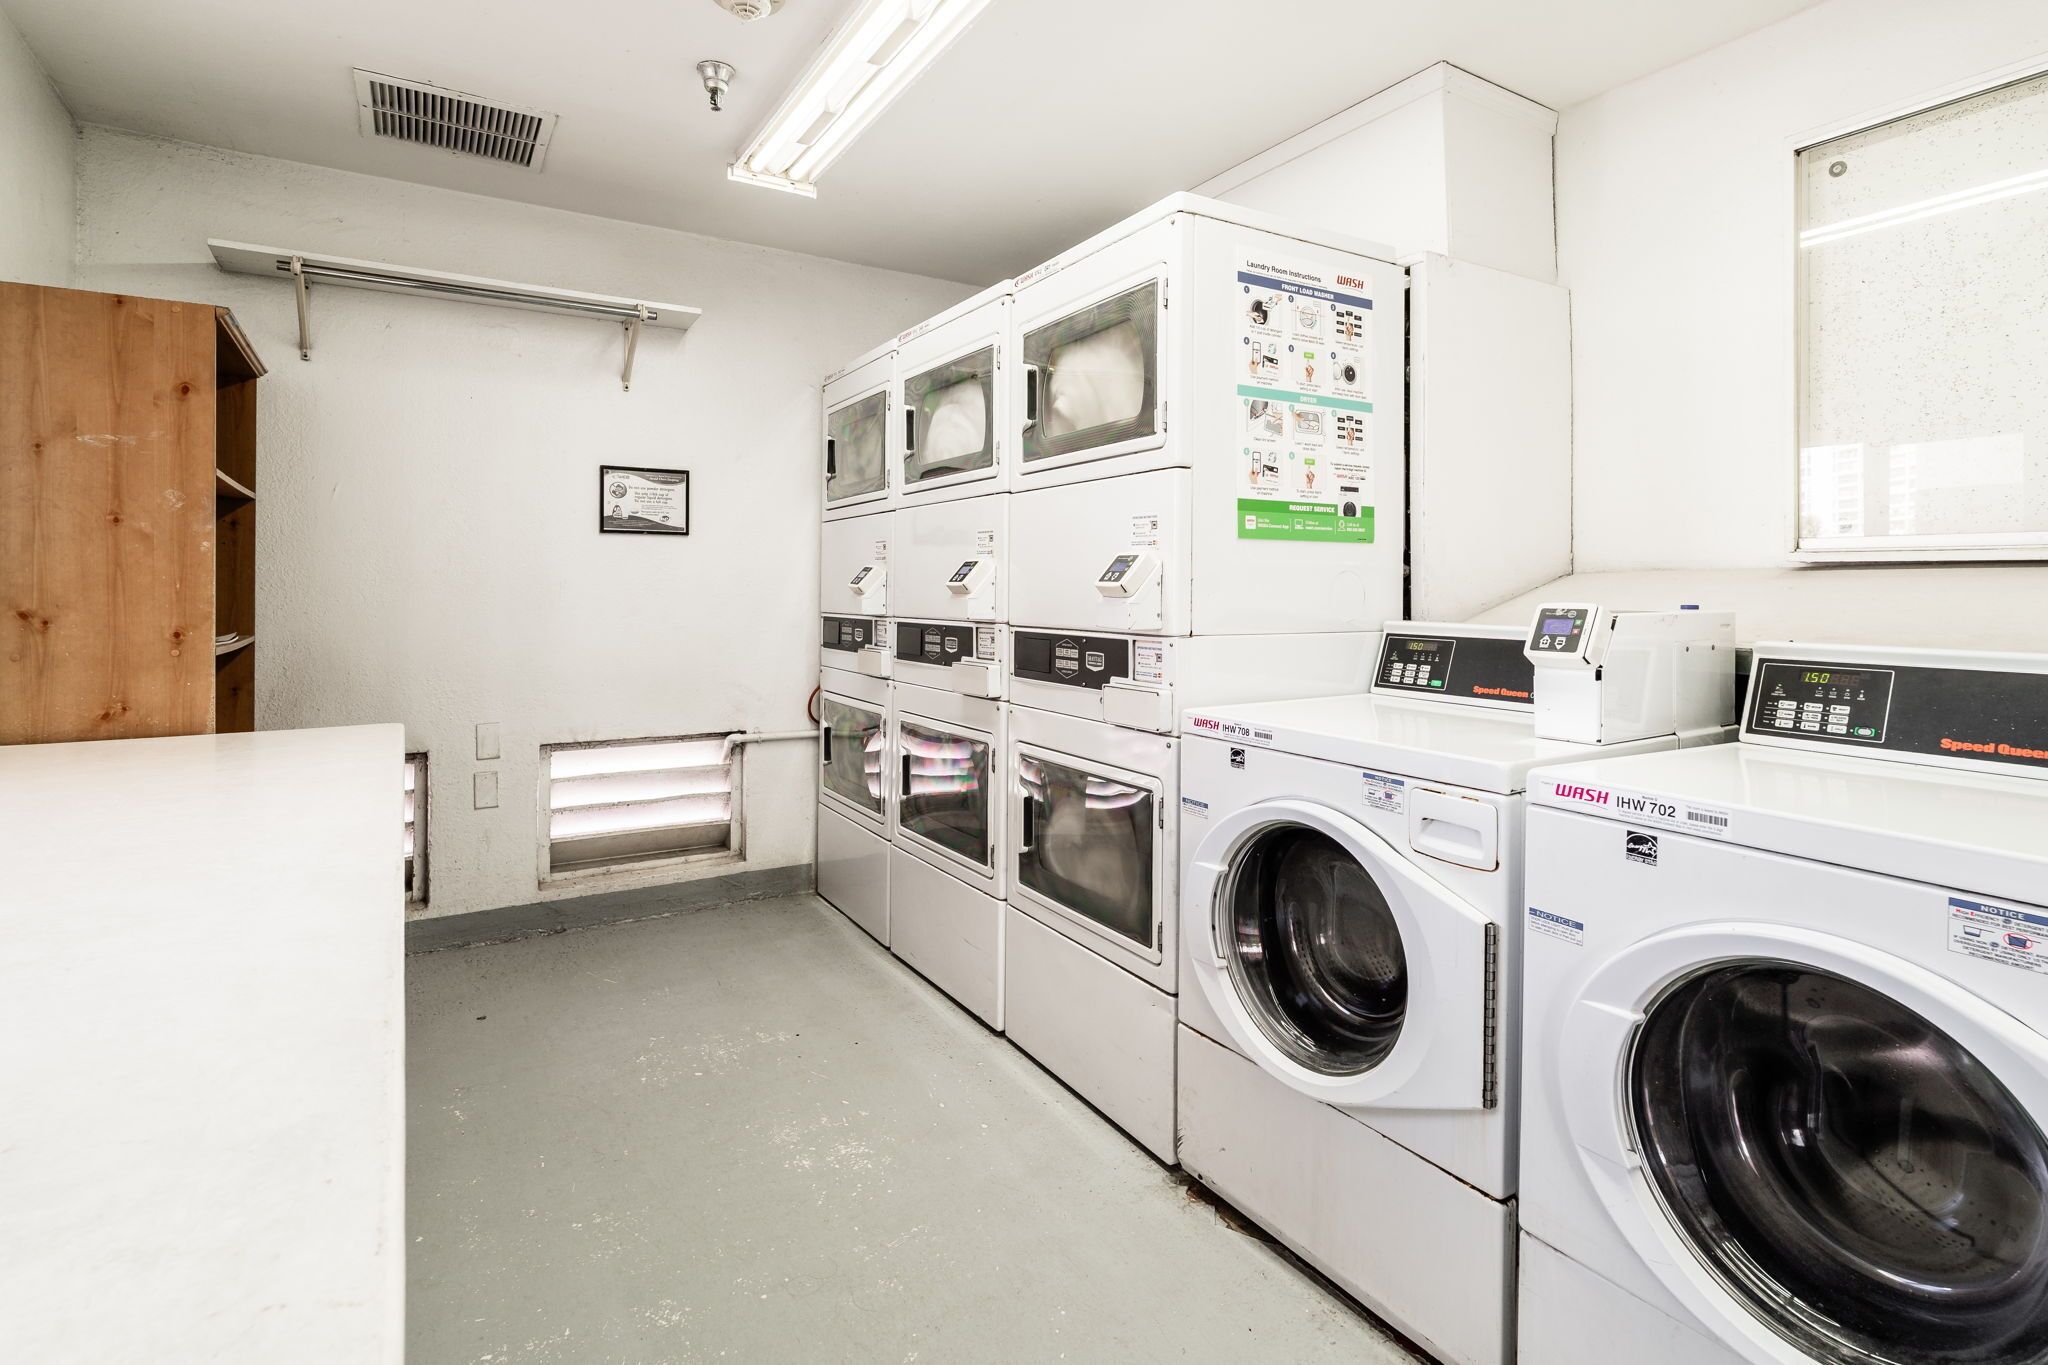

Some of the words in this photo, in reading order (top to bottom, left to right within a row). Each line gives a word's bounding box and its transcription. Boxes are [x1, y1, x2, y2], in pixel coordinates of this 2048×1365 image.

[1246, 260, 1270, 272] Laundry
[1272, 266, 1288, 276] Room
[1289, 270, 1322, 282] Instructions
[1336, 274, 1364, 290] WASH
[1282, 284, 1299, 293] FRONT
[1300, 288, 1313, 296] LOAD
[1472, 685, 1499, 696] Speed
[1500, 689, 1529, 698] Queen
[1194, 717, 1219, 730] WASH
[1222, 724, 1237, 733] IHW
[1237, 727, 1250, 737] 708
[1940, 738, 1996, 754] Speed
[1998, 744, 2048, 759] Quee
[1556, 784, 1609, 804] WASH
[1616, 796, 1646, 812] IHW
[1650, 802, 1676, 818] 702
[1536, 911, 1576, 927] NOTICE
[1952, 913, 1989, 925] RECOMMENDED
[1980, 906, 2025, 920] NOTICE
[2014, 922, 2044, 932] DETERGENT
[1962, 946, 1993, 956] DETERGENT
[1969, 952, 2010, 965] RECOMMENDED
